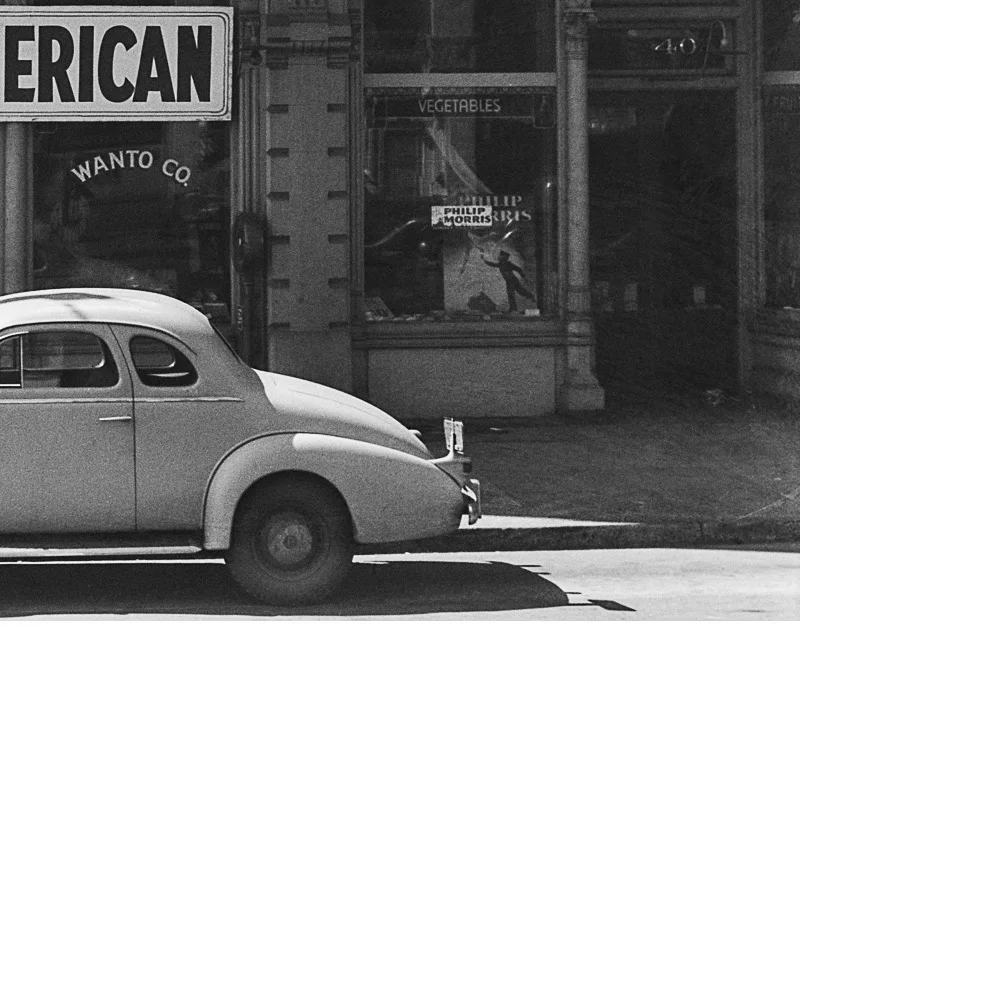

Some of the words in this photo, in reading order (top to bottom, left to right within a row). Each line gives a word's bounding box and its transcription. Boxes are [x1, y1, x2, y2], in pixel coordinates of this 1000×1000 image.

[418, 98, 502, 113] VEGETABLES
[70, 149, 155, 184] WANTO
[161, 158, 192, 188] CO.
[459, 195, 522, 207] PHILIP
[443, 207, 486, 215] PHILIP
[491, 209, 532, 222] RRIS
[443, 215, 492, 224] MORRIS
